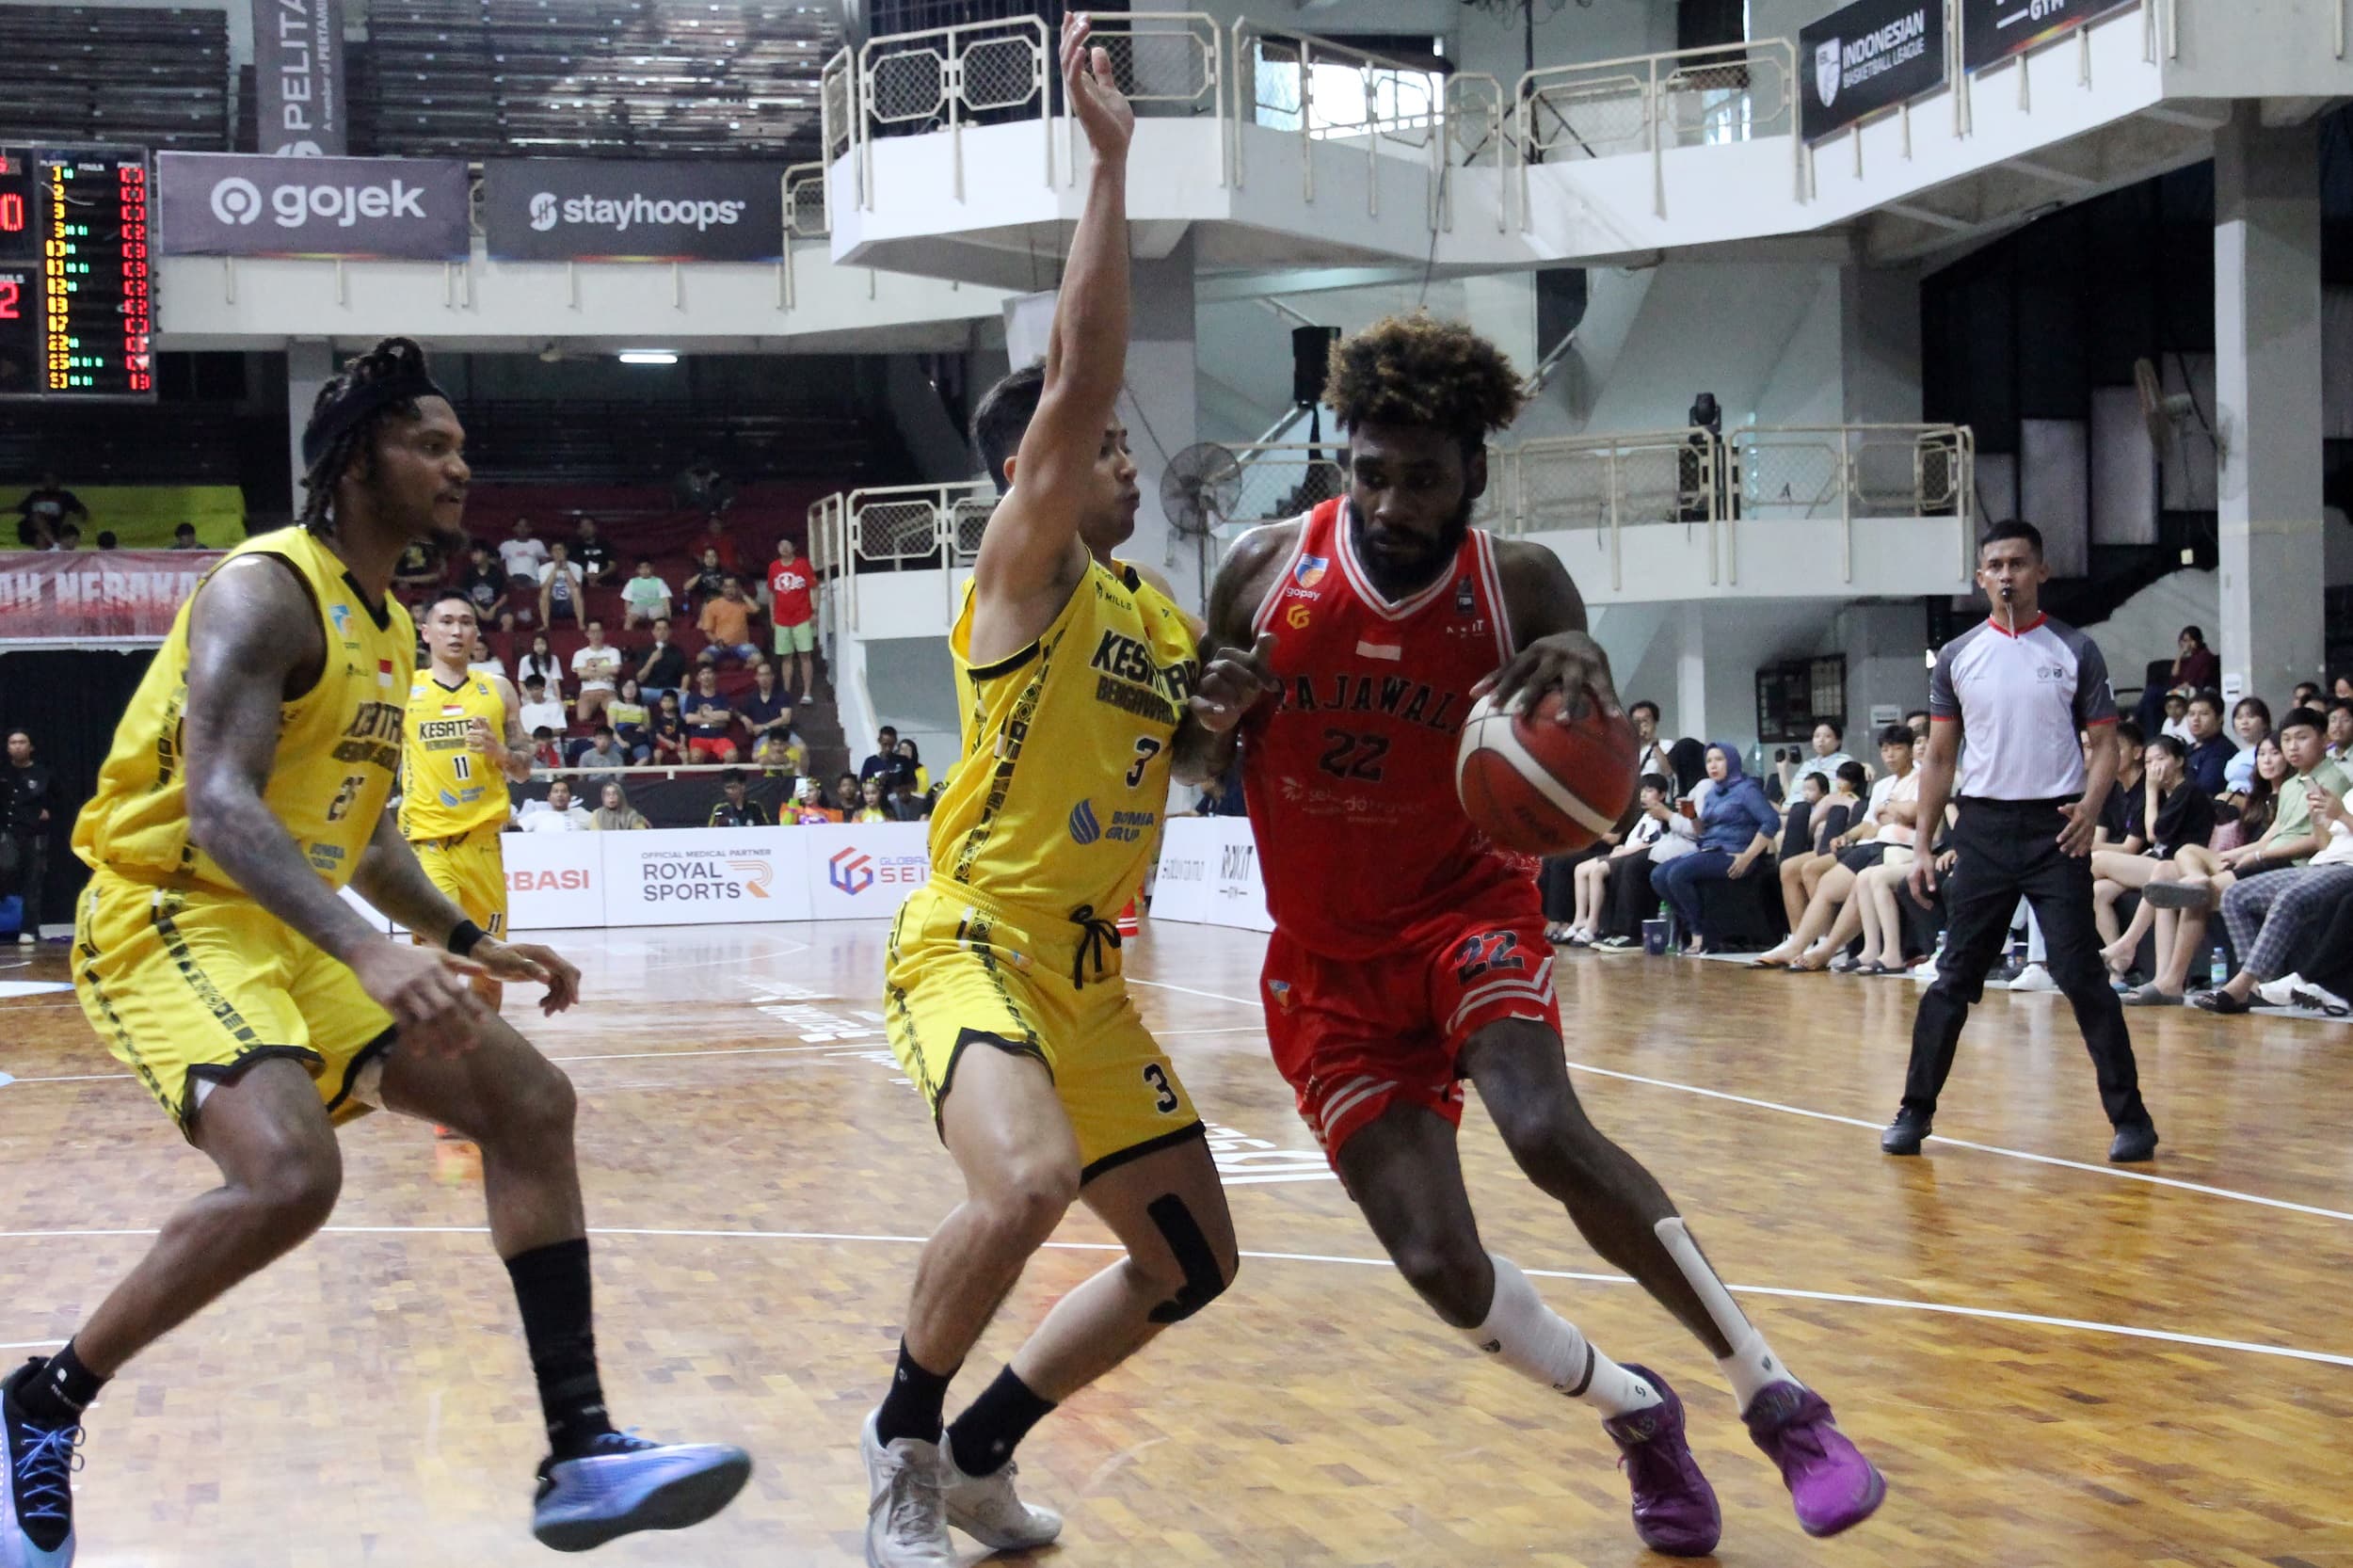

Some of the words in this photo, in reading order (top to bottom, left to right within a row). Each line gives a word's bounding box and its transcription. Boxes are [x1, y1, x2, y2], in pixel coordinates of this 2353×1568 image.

[1843, 8, 1925, 69] INDONESIAN
[1843, 55, 1893, 88] BASKETBALL
[1893, 37, 1925, 65] LEAGUE
[272, 179, 426, 228] gojek
[564, 193, 739, 232] stayhoops
[1287, 587, 1321, 601] gopay
[454, 756, 470, 779] 11
[1126, 737, 1160, 788] 3
[1320, 728, 1390, 783] 22
[641, 851, 683, 859] OFFICIAL
[643, 861, 723, 881] ROYAL
[644, 882, 741, 902] SPORTS
[1455, 930, 1525, 986] 22
[1143, 1063, 1178, 1113] 3
